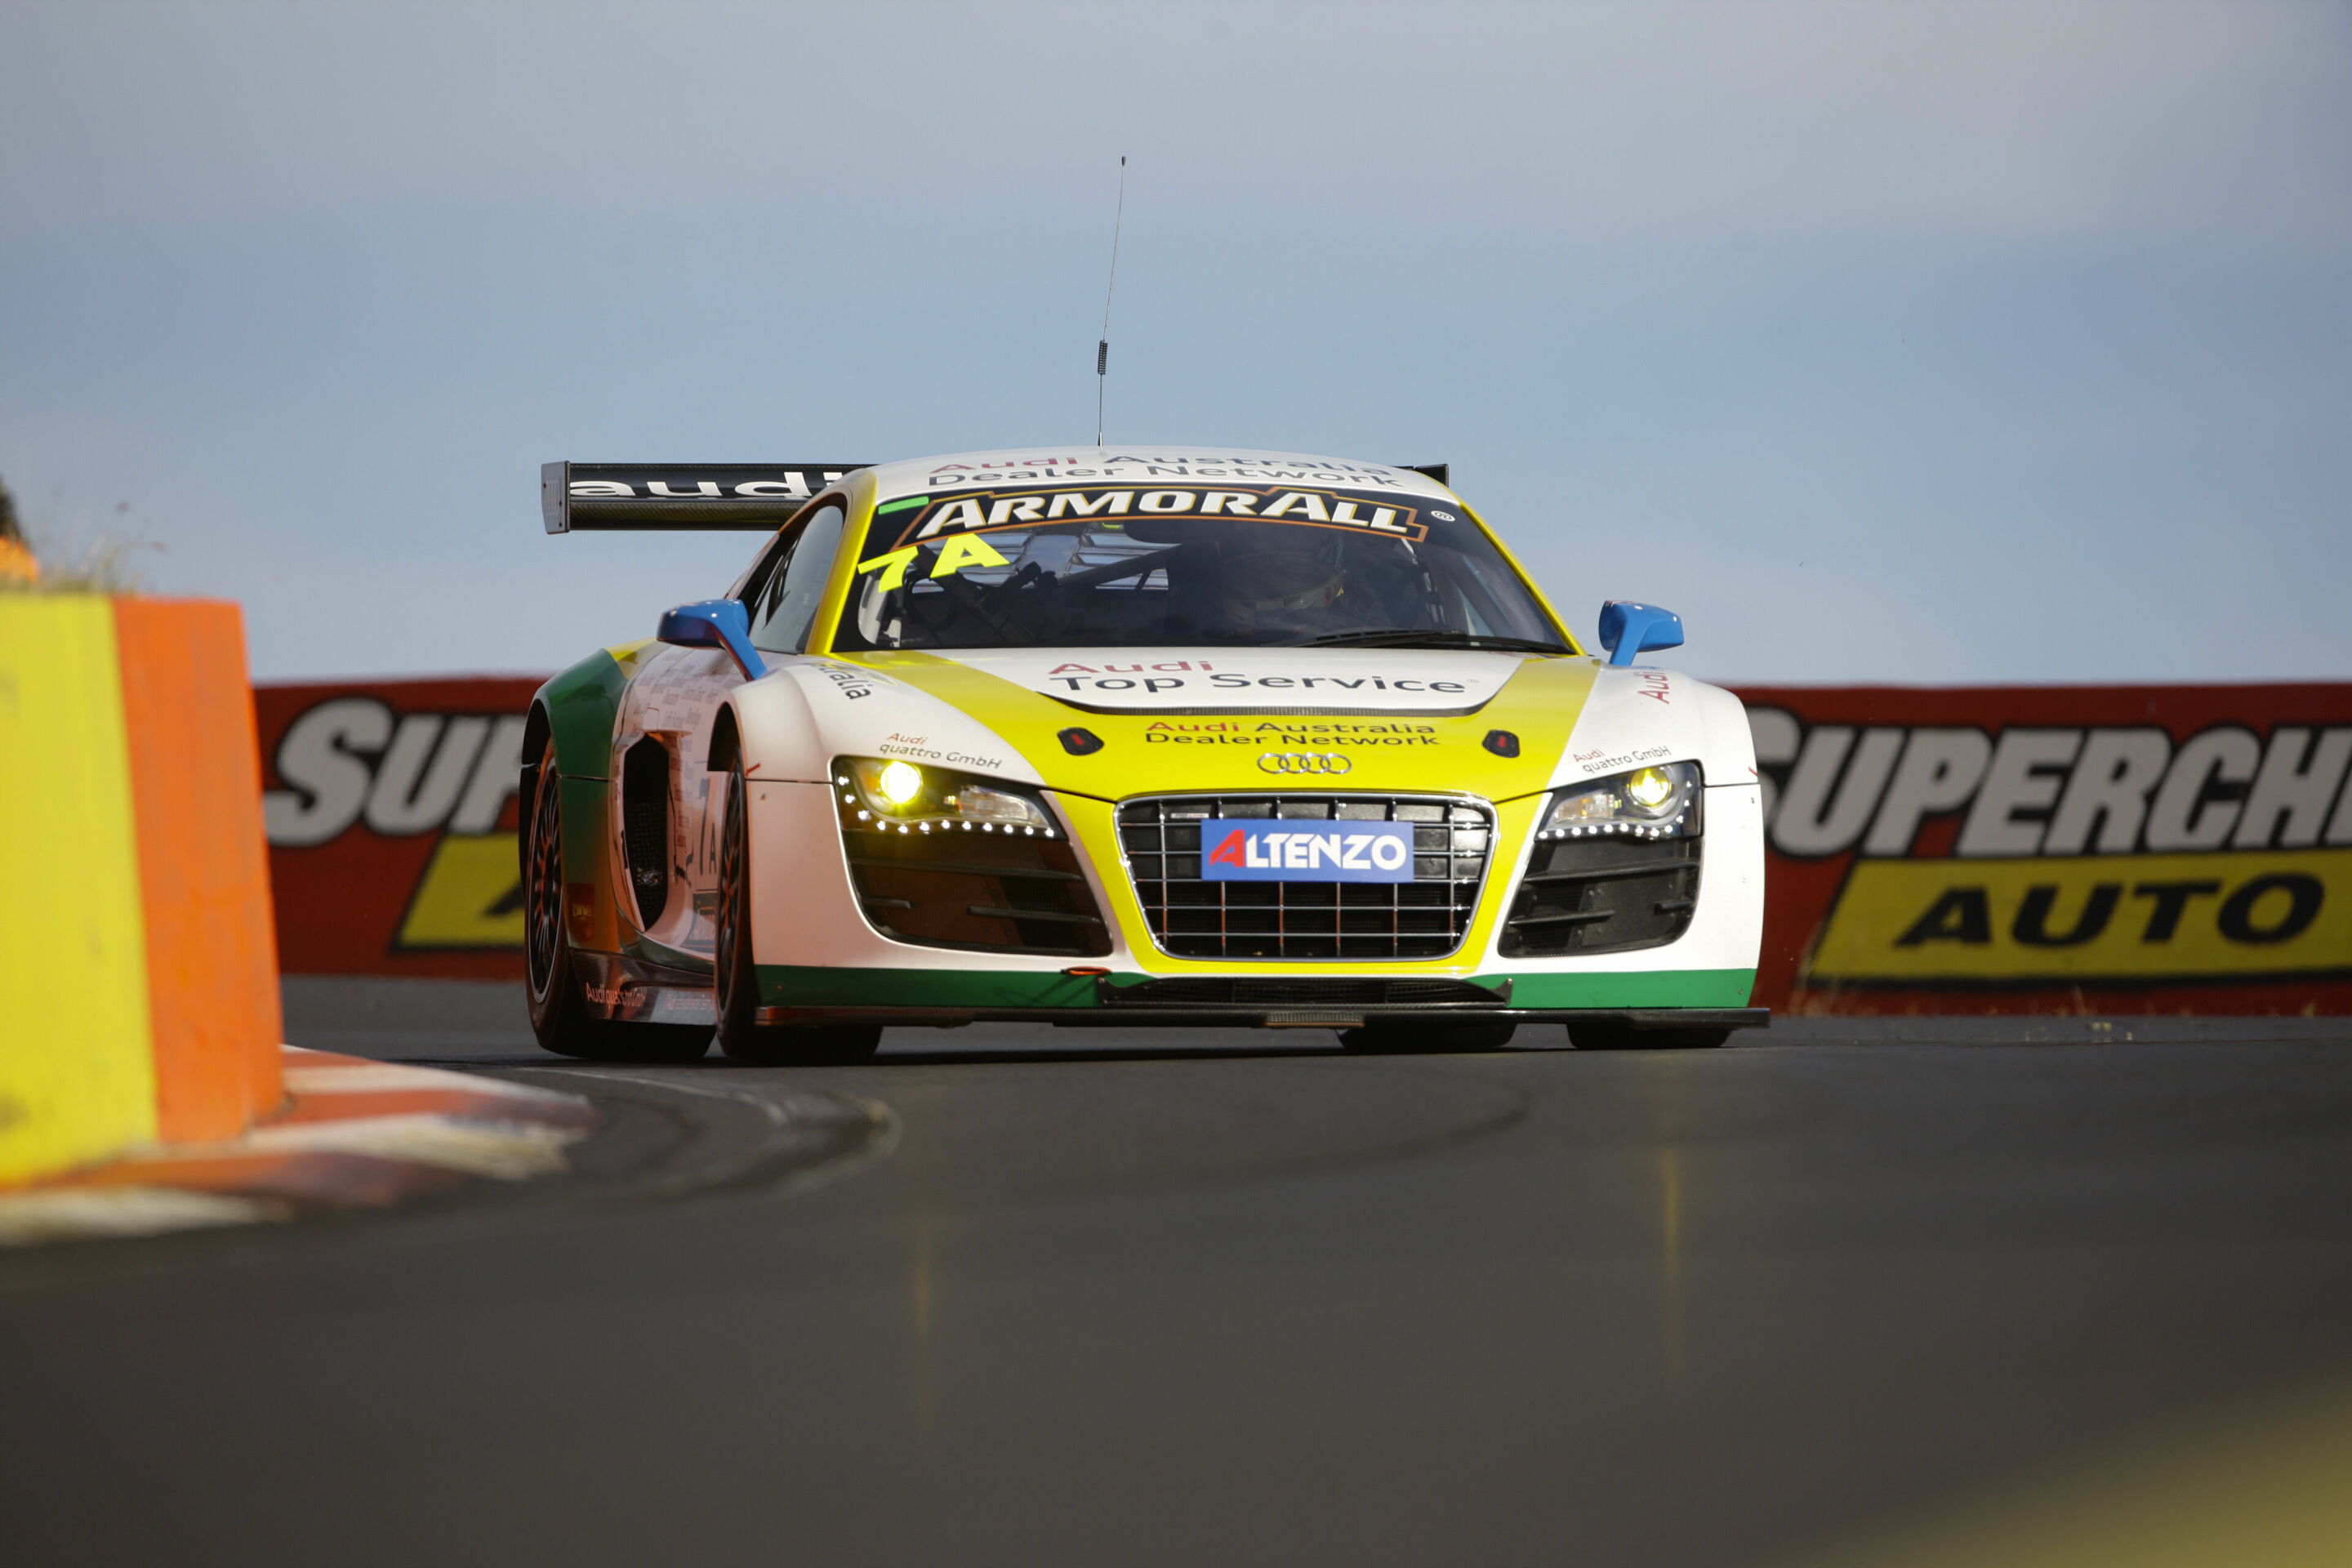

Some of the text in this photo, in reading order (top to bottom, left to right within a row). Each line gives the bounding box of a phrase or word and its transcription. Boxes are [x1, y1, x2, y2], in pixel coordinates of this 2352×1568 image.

[928, 465, 1408, 488] Dealer Network
[929, 456, 1393, 477] Audi Australia
[1049, 660, 1214, 675] Audi
[1049, 673, 1467, 694] Top Service
[1633, 671, 1670, 705] Audi
[1147, 720, 1437, 734] Audi Australia
[886, 732, 929, 745] Audi
[1145, 733, 1441, 746] Dealer Network
[879, 743, 1003, 769] quattro GmbH
[1573, 749, 1606, 762] Audi
[1582, 745, 1673, 774] quattro GmbH
[1209, 829, 1407, 871] ALTENZO
[1893, 873, 2326, 948] AUTO
